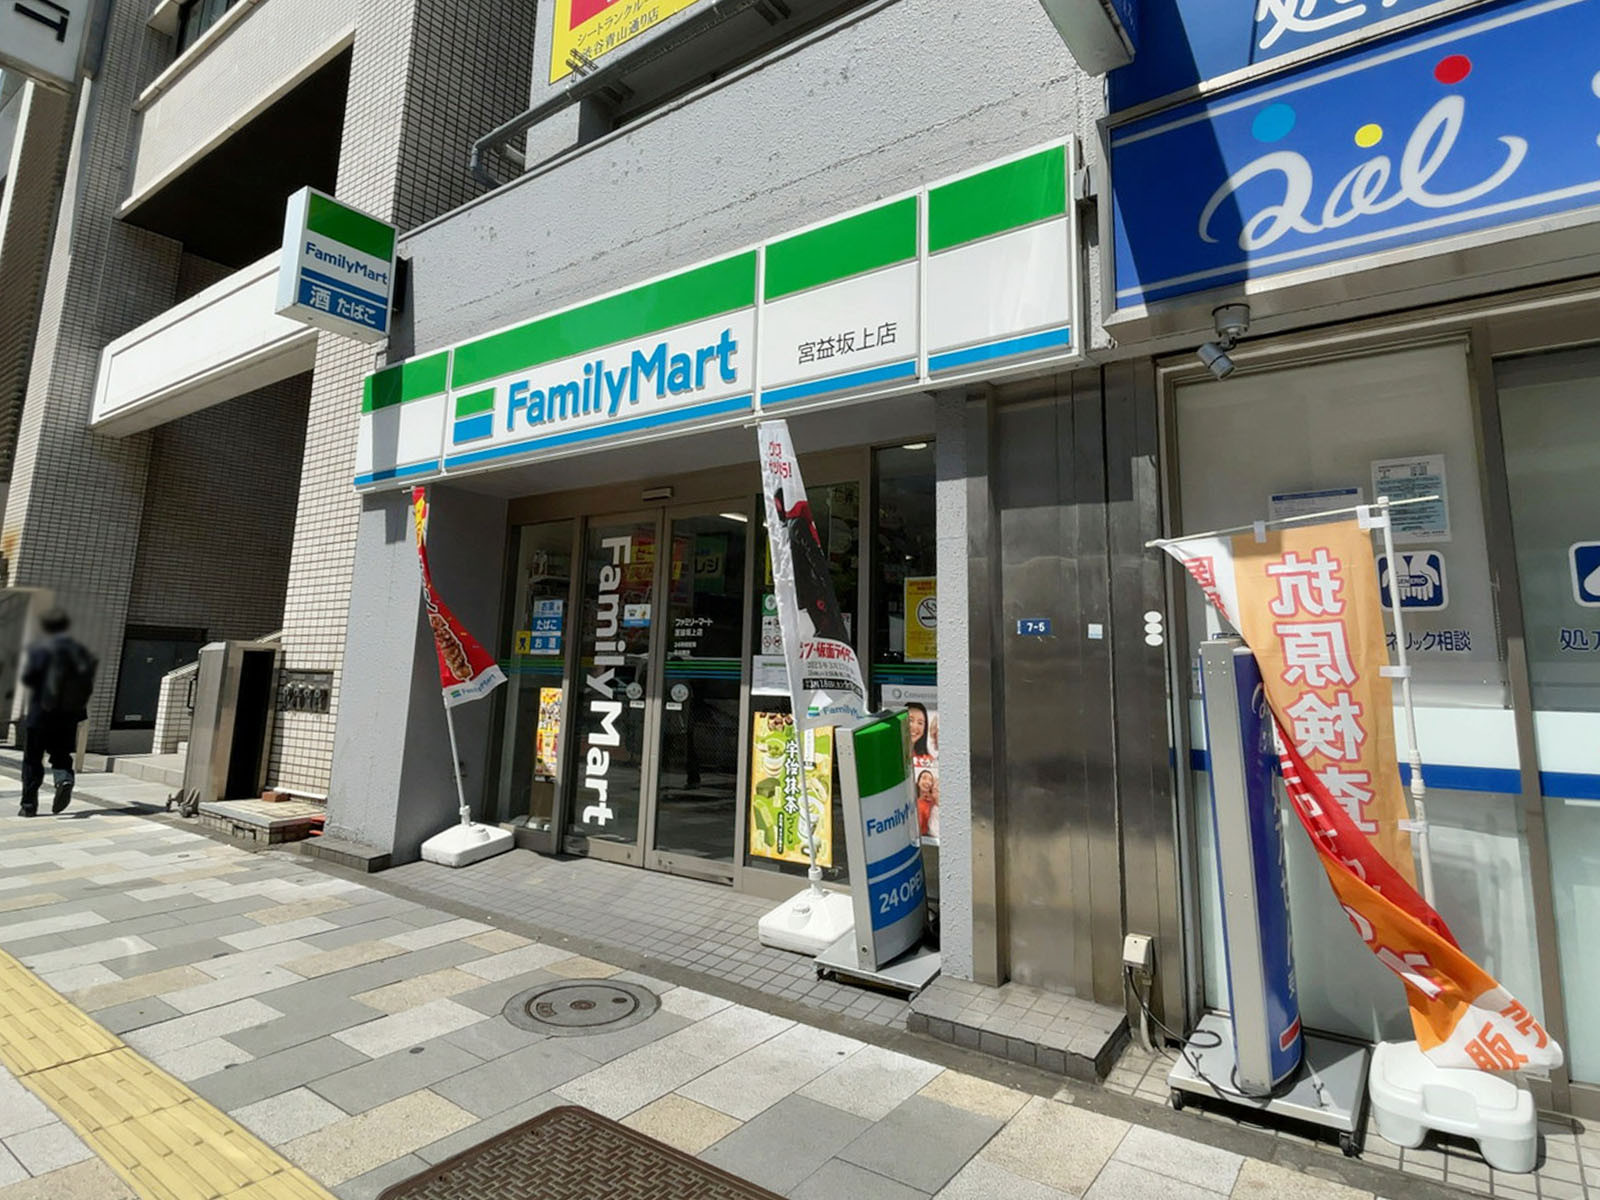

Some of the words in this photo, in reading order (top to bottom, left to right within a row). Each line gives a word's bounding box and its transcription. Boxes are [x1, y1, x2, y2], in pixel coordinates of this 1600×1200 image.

[305, 241, 388, 285] FamilyMart
[309, 285, 331, 311] 酒
[336, 298, 376, 325] たばこ
[797, 322, 897, 365] 宮益坂上店
[507, 328, 738, 433] FamilyMart
[1026, 621, 1045, 632] 7-5
[582, 535, 632, 826] FamilyMart
[785, 740, 800, 815] 宇治抹茶
[879, 889, 900, 914] 24
[900, 870, 922, 903] OPE
